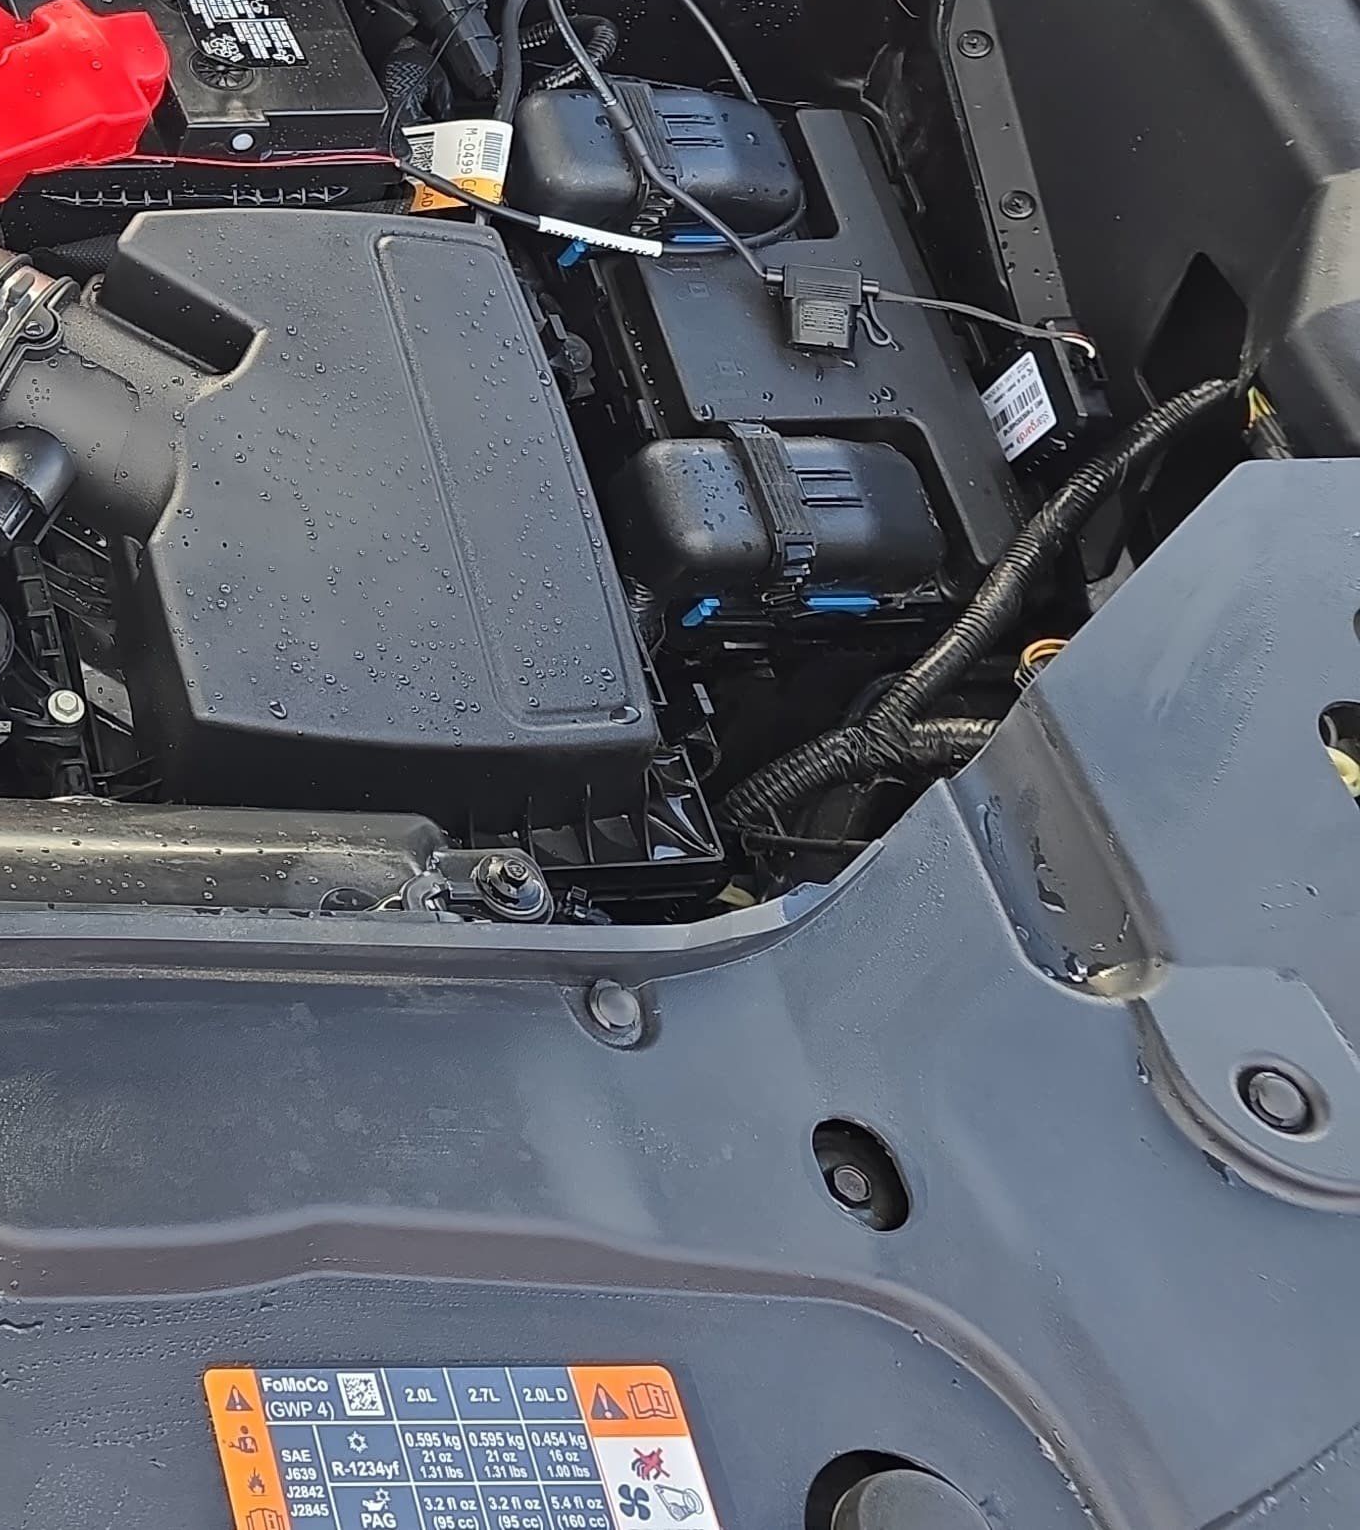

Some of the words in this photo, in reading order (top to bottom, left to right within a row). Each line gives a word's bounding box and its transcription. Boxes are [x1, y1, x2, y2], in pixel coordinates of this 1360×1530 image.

[261, 1377, 329, 1392] FoMoCo
[404, 1388, 438, 1403] 2.0L
[468, 1388, 501, 1403] 2.7L
[523, 1387, 554, 1402] 2.0L
[555, 1387, 569, 1402] D
[265, 1401, 313, 1420] (GWP
[317, 1401, 335, 1421] 4)
[404, 1432, 441, 1448] 0.595
[443, 1432, 462, 1451] kg
[469, 1432, 505, 1448] 0.595
[507, 1432, 526, 1451] kg
[531, 1432, 567, 1448] 0.454
[569, 1432, 588, 1451] kg
[281, 1450, 312, 1463] SAE
[422, 1450, 436, 1463] 21
[438, 1452, 454, 1463] oz
[487, 1450, 501, 1463] 21
[502, 1452, 518, 1463] oz
[549, 1449, 563, 1463] 16
[564, 1452, 580, 1463] oz
[285, 1467, 317, 1481] J639
[331, 1461, 400, 1479] R-1234yf
[419, 1466, 444, 1479] 1.31
[446, 1466, 464, 1479] lbs
[484, 1466, 509, 1479] 1.31
[510, 1466, 528, 1479] lbs
[547, 1466, 571, 1479] 1.00
[573, 1466, 591, 1478] lbs
[286, 1485, 325, 1499] J2842
[290, 1503, 329, 1517] J2845
[424, 1497, 446, 1511] 3.2
[448, 1496, 459, 1510] fl
[460, 1499, 478, 1511] oz
[487, 1497, 509, 1511] 3.2
[511, 1496, 523, 1510] fl
[524, 1499, 542, 1511] oz
[550, 1496, 572, 1510] 5.4
[573, 1496, 585, 1510] fl
[588, 1498, 604, 1509] oz
[361, 1513, 397, 1530] PAG
[433, 1514, 456, 1530] (95
[458, 1514, 479, 1530] cc)
[498, 1514, 521, 1530] (95
[522, 1514, 544, 1530] cc)
[557, 1513, 586, 1530] (160
[588, 1513, 610, 1530] cc)
